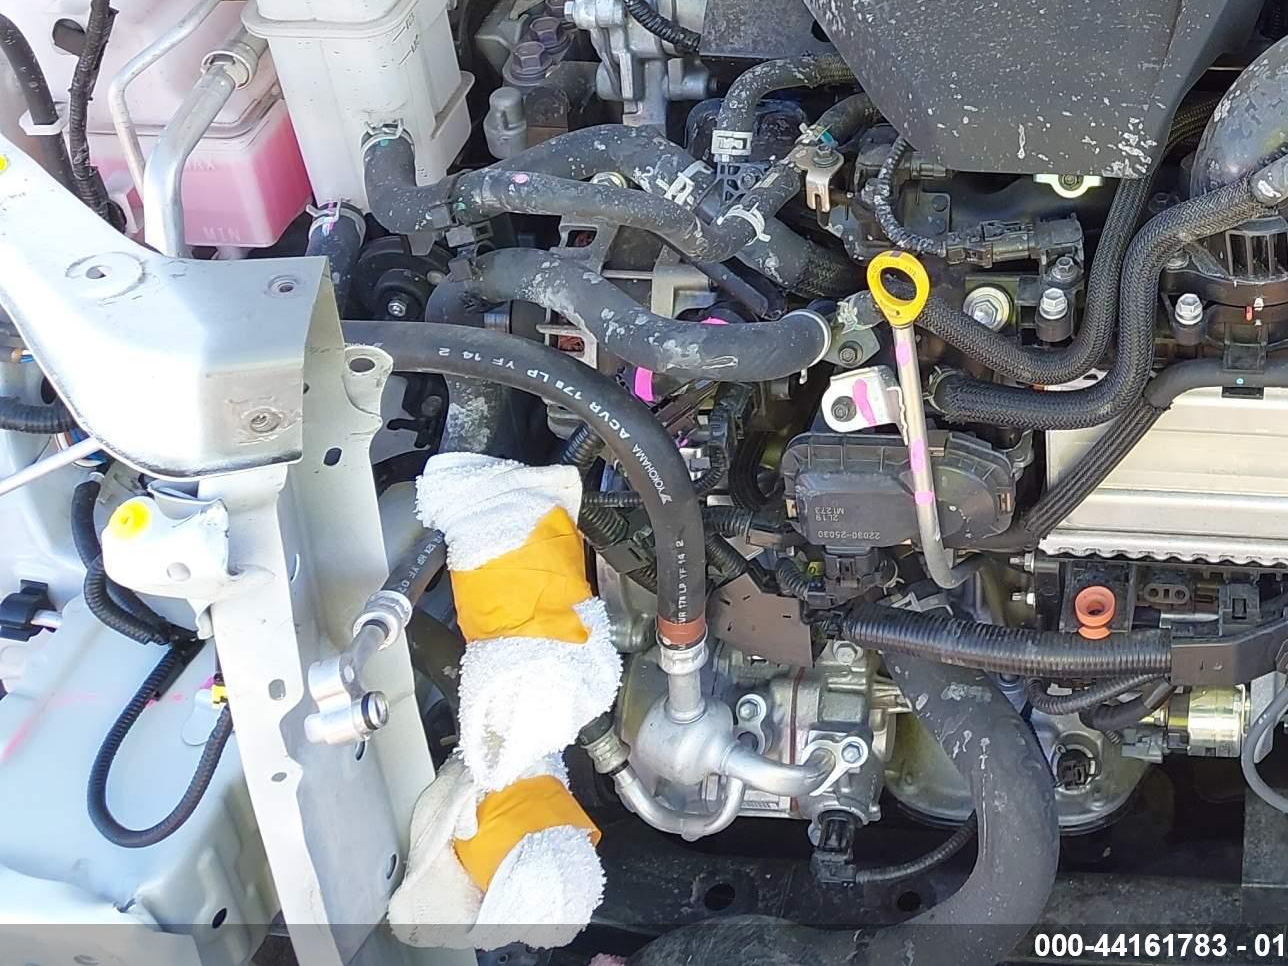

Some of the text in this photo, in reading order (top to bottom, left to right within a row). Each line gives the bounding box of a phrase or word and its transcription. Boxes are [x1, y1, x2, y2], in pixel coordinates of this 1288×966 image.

[438, 347, 451, 356] 2
[461, 350, 482, 362] 14
[492, 357, 516, 370] YF
[526, 369, 549, 383] LP
[588, 401, 631, 440] ACVR
[631, 442, 668, 499] YOKOHAMA
[817, 530, 881, 540] 22030-25030
[675, 539, 685, 548] 2
